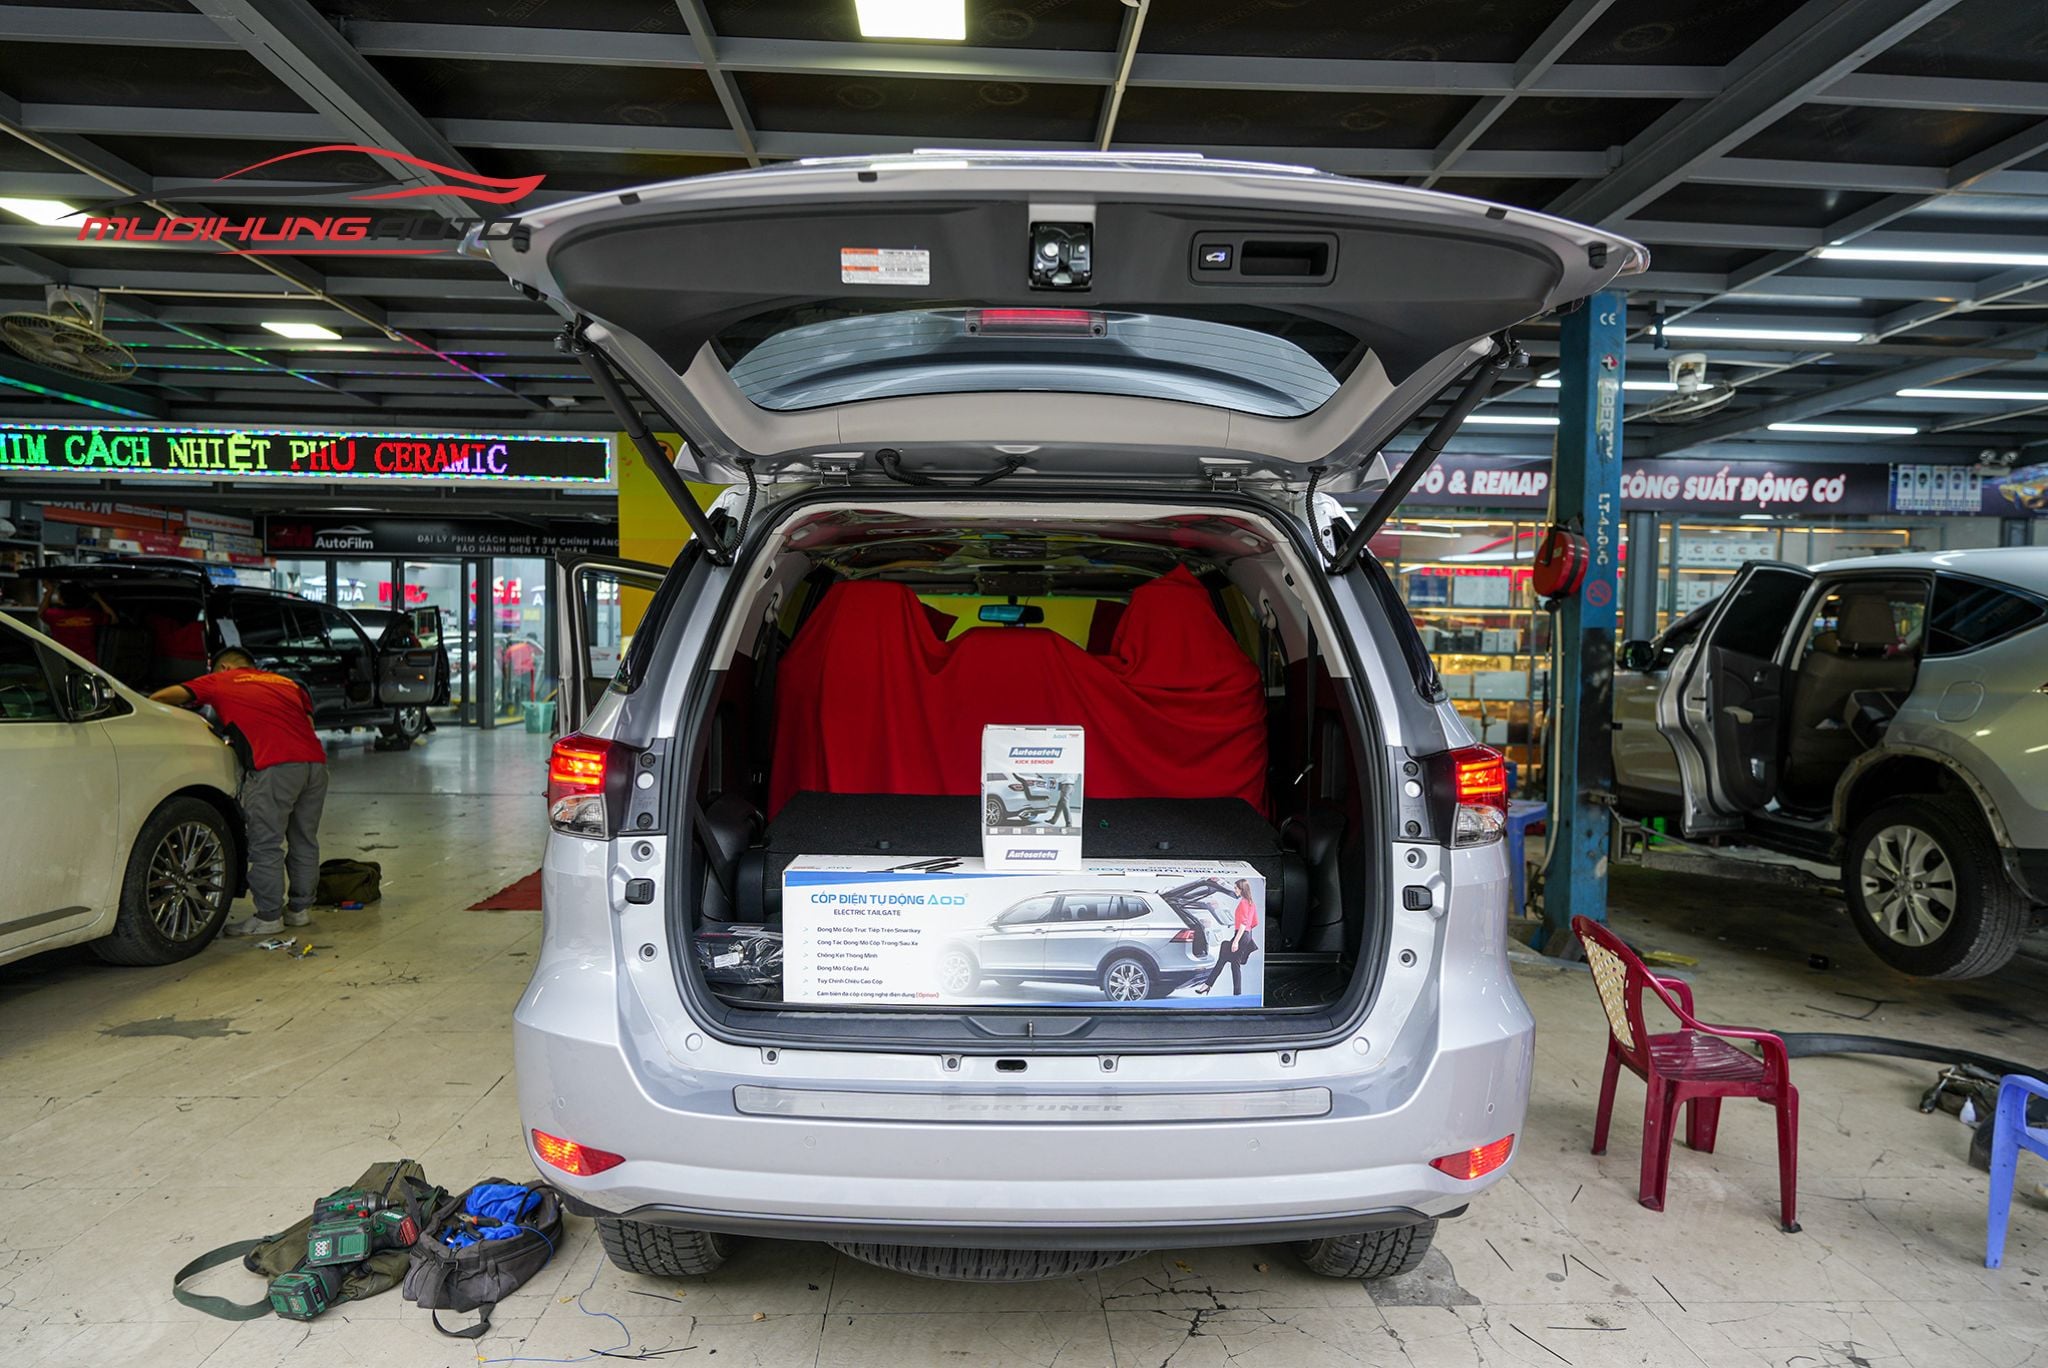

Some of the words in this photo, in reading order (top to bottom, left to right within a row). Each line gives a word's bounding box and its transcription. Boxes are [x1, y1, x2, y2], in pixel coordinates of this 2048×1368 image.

[65, 431, 152, 466] CÁCH
[168, 433, 271, 471] NHIỆT
[374, 442, 508, 474] CERAMIC
[1448, 468, 1467, 495] &
[1471, 470, 1548, 496] REMAP
[1619, 469, 1680, 500] CÔNG
[1683, 466, 1739, 501] SUẤT
[1740, 472, 1809, 508] ĐỘNG
[1812, 474, 1847, 503] CƠ
[315, 536, 374, 549] AutoFilm
[451, 535, 475, 544] PHIM
[478, 535, 506, 544] CÁCH
[833, 908, 866, 916] ELECTRIC
[868, 909, 901, 917] TAILGATE
[947, 1103, 1123, 1112] FORTUNER
